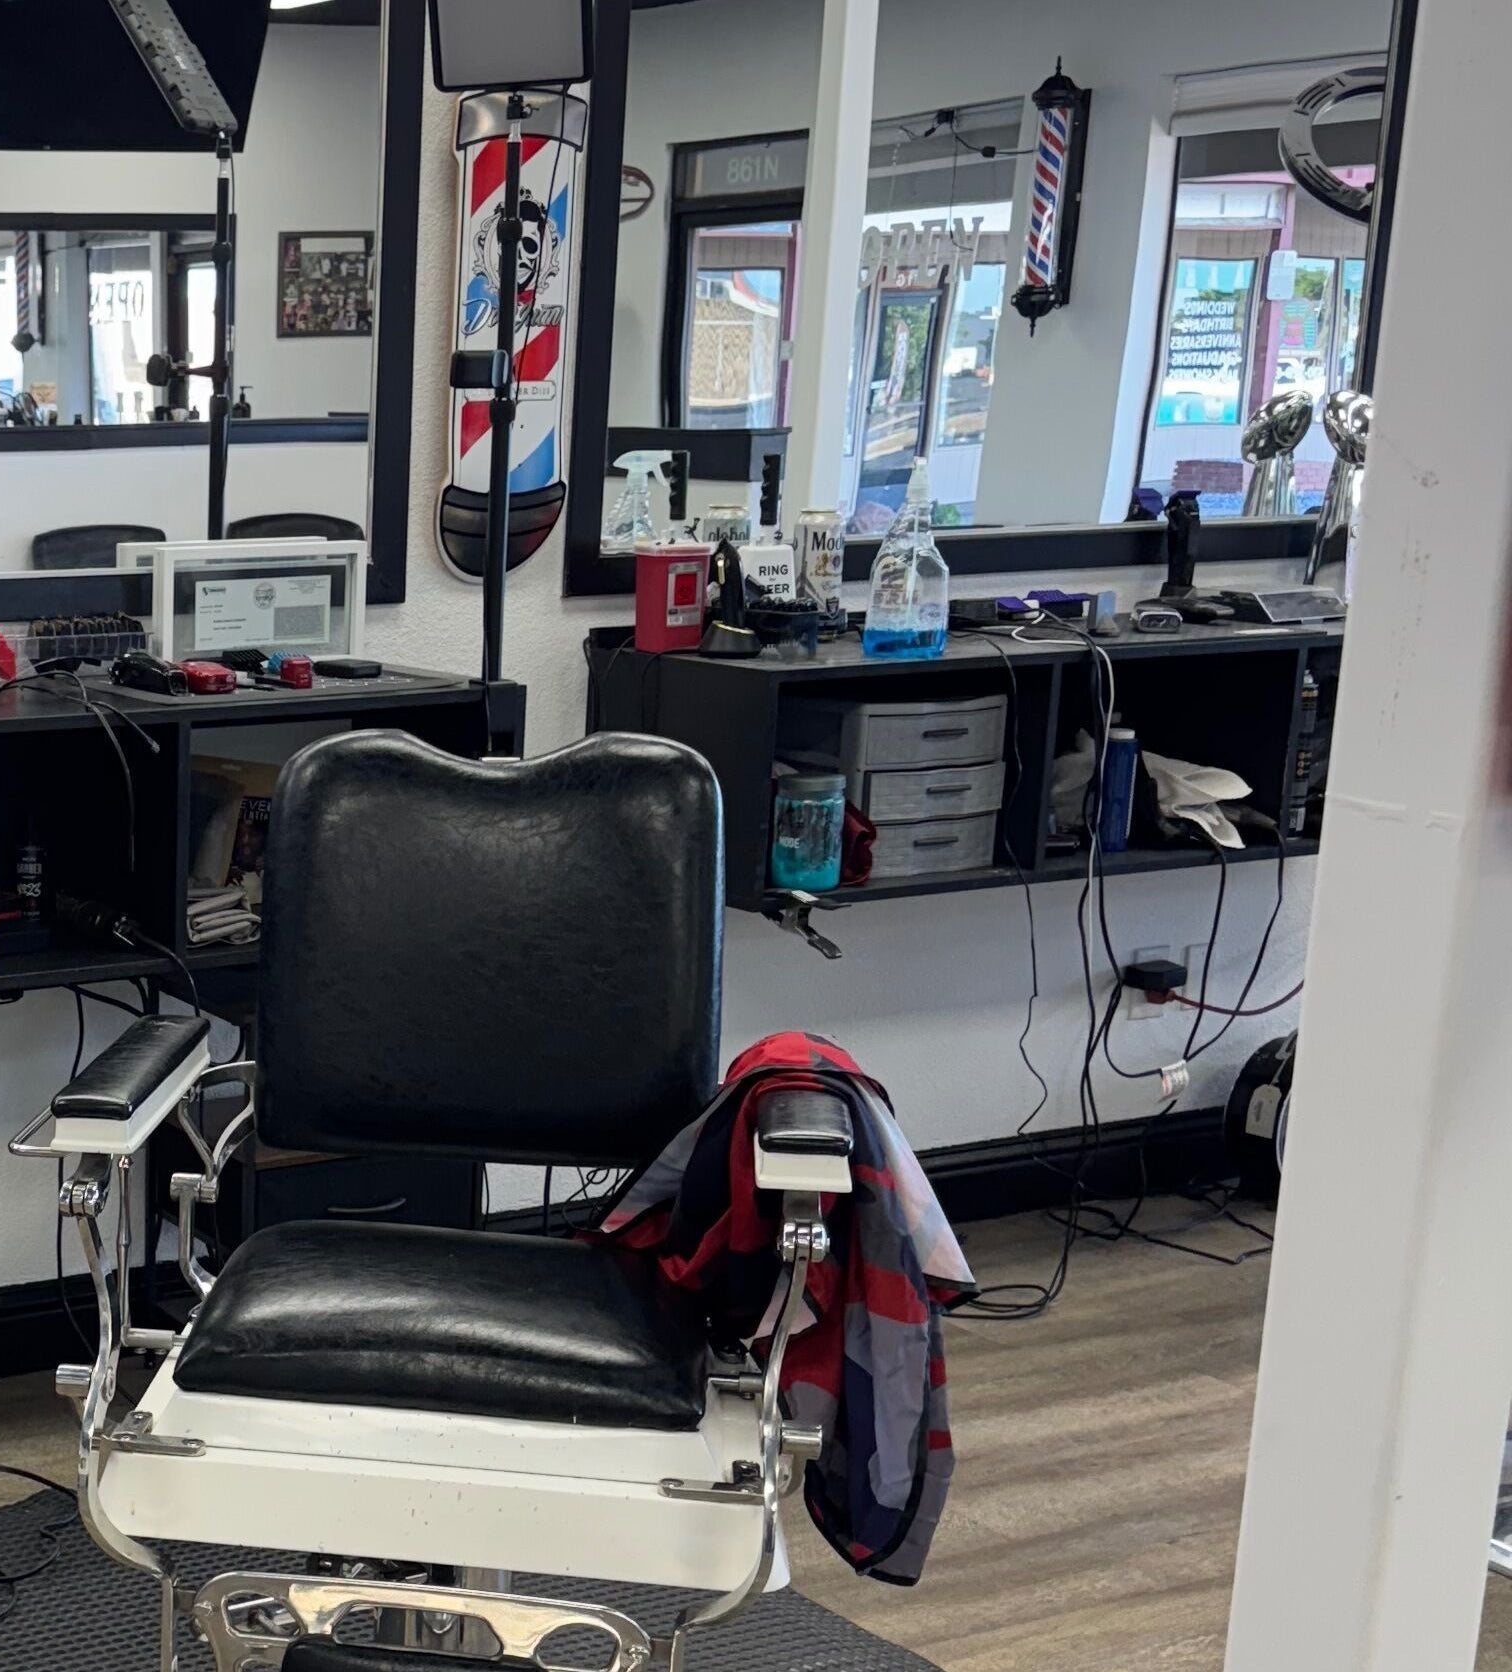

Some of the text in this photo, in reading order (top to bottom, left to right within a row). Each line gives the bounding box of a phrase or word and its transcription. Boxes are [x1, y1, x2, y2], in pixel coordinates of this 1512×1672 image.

[728, 155, 778, 183] 861N
[858, 216, 984, 289] OPEN
[759, 565, 788, 576] RING
